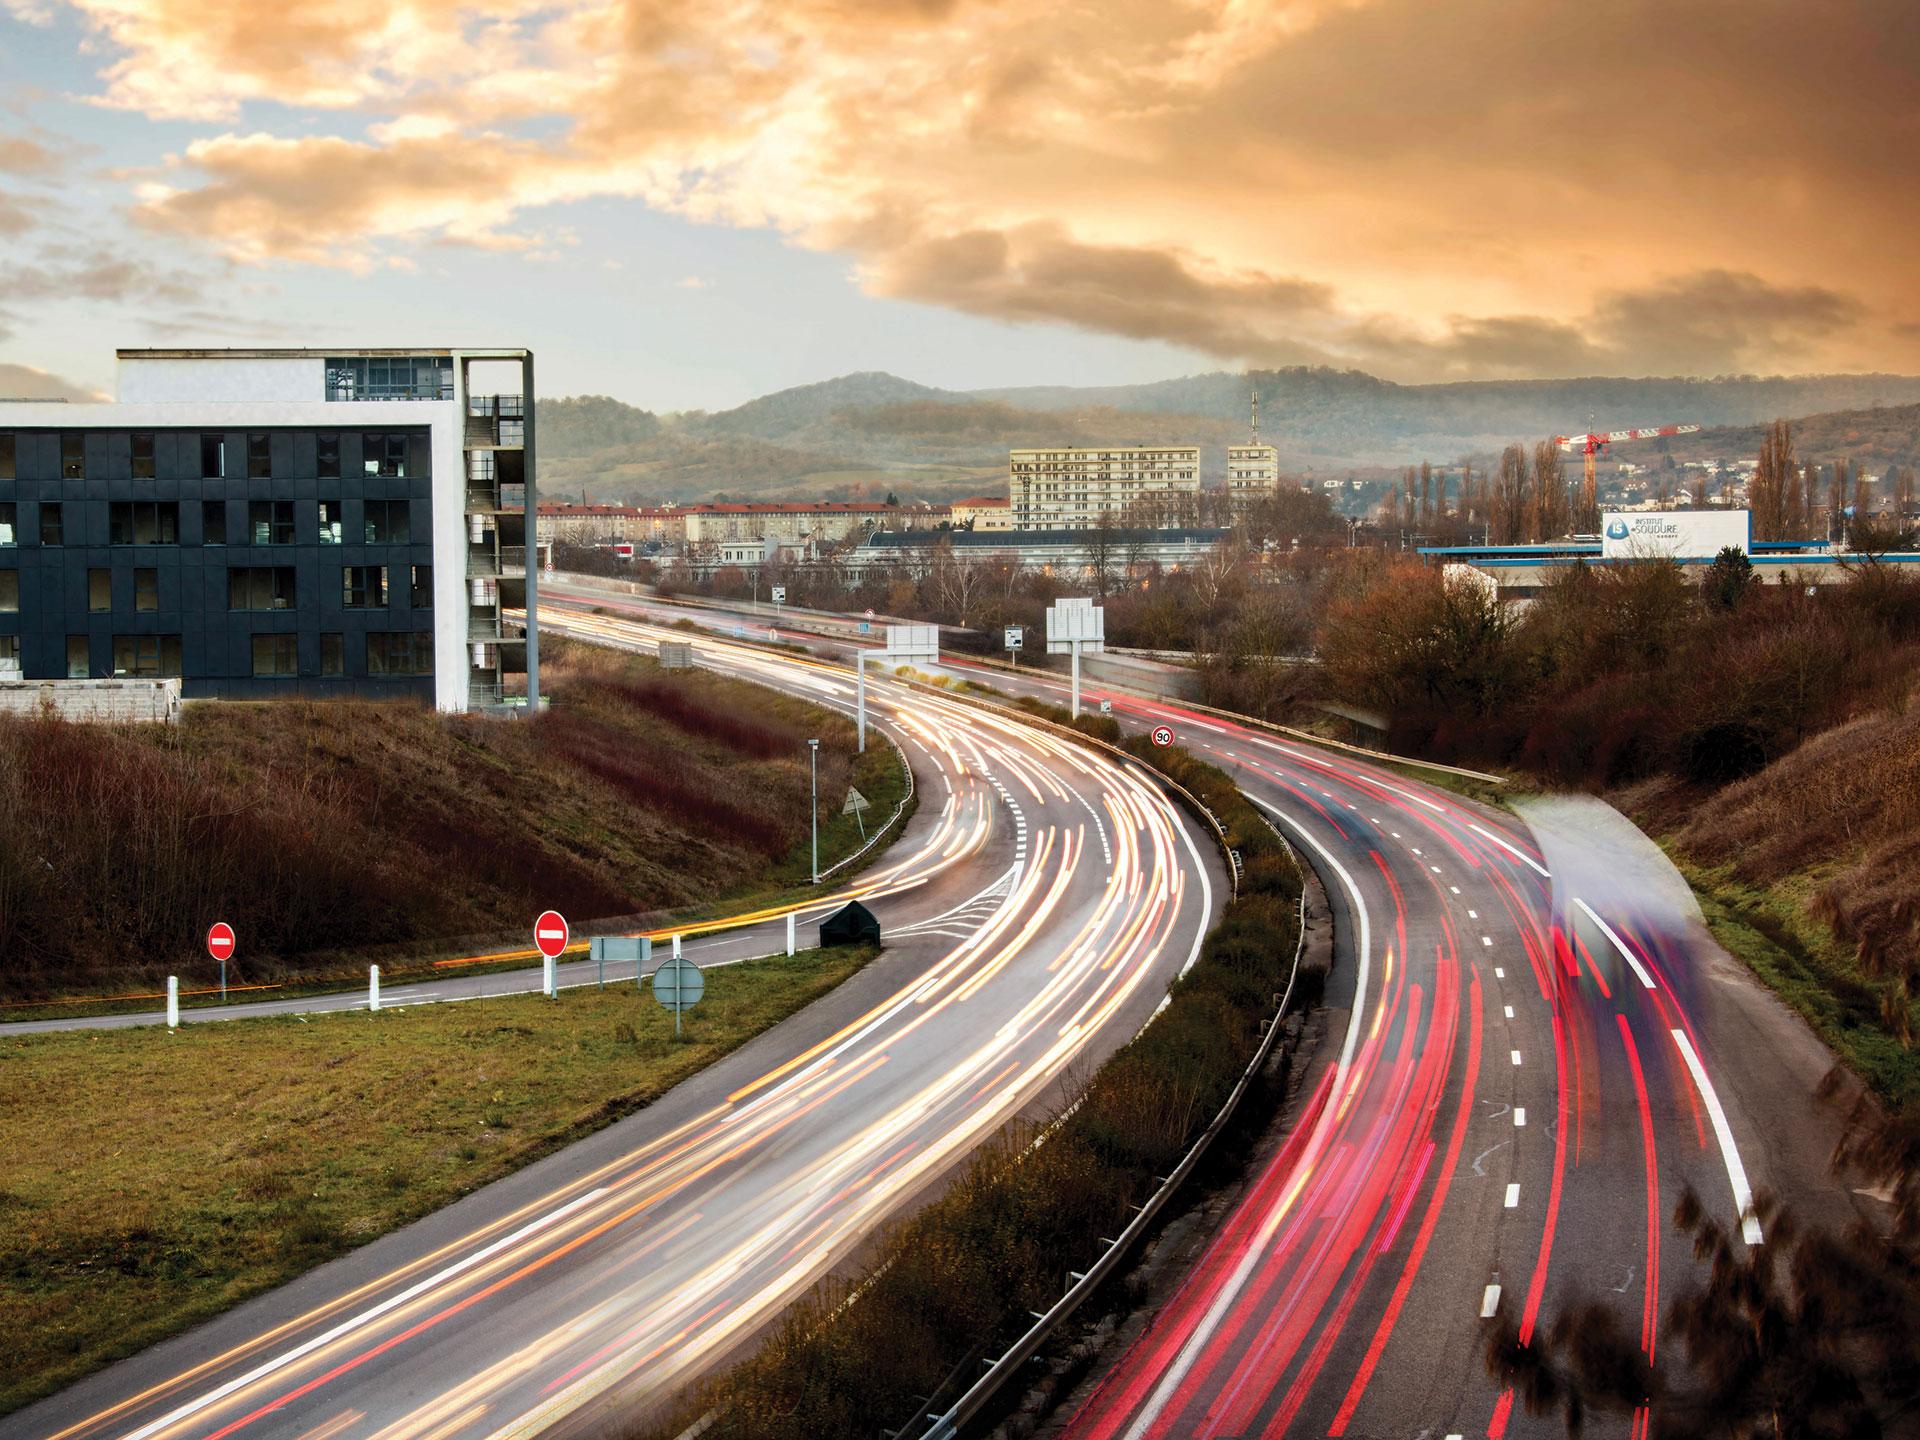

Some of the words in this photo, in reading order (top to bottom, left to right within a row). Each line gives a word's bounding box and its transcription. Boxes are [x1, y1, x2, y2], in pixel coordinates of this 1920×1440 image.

[1612, 524, 1623, 534] IS
[1635, 525, 1677, 534] SOUDURE
[1157, 732, 1170, 742] 90
